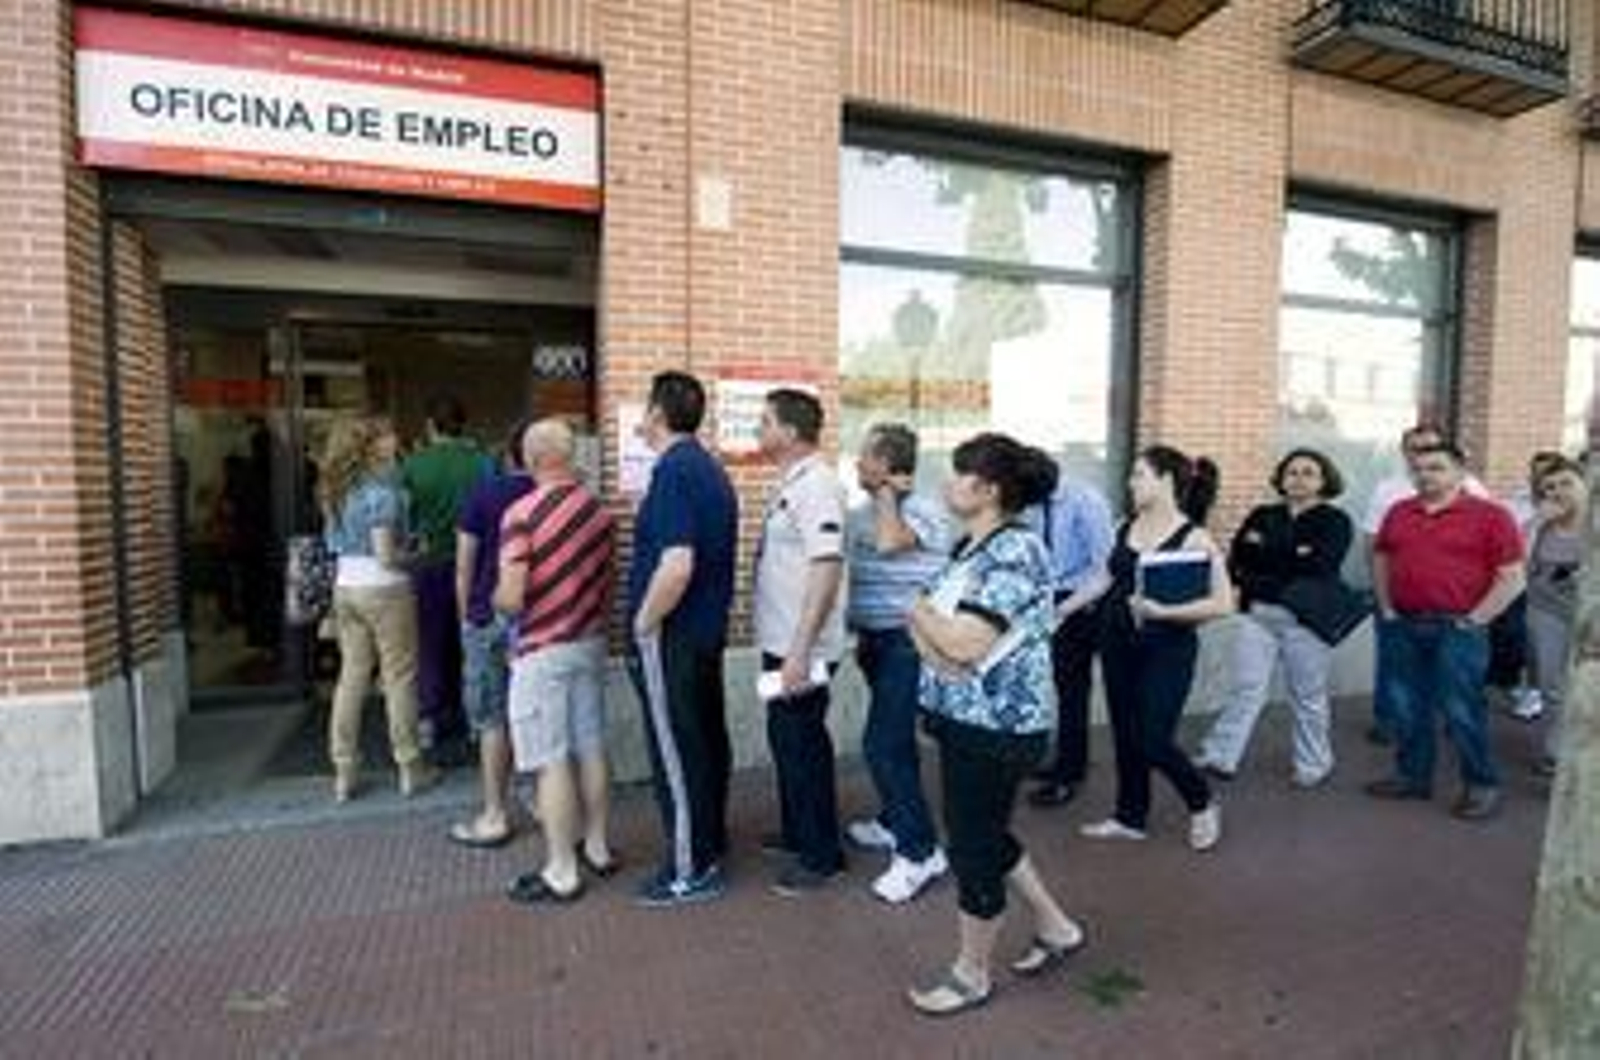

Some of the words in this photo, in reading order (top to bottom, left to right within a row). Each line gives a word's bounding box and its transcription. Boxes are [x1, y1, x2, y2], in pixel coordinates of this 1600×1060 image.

[130, 83, 315, 133] OFICINA
[326, 103, 382, 140] DE
[397, 111, 559, 159] EMPLEO
